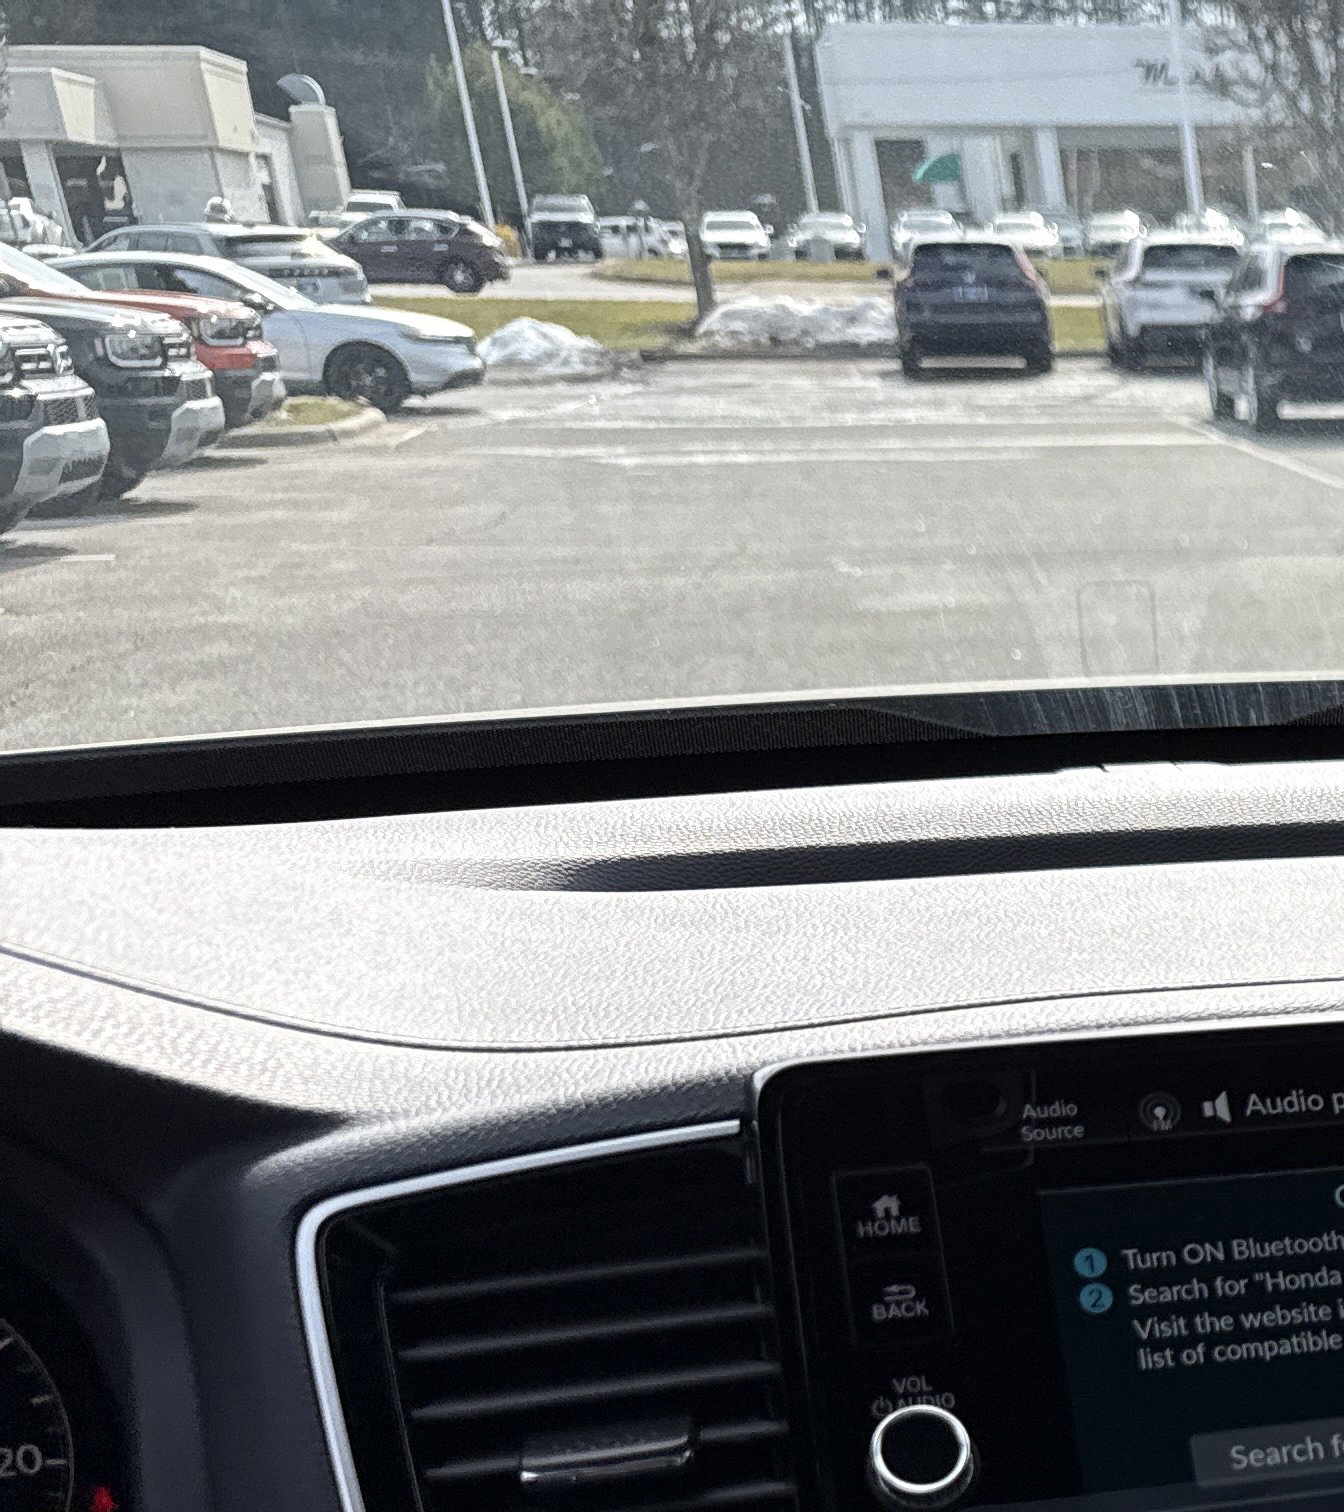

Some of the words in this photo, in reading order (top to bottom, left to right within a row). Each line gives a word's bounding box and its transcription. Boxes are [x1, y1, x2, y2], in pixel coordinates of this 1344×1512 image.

[1022, 1099, 1079, 1120] Audio
[1244, 1087, 1326, 1118] Audio
[1020, 1124, 1086, 1143] Source
[856, 1216, 922, 1238] HOME
[1122, 1246, 1176, 1272] Turn
[1183, 1240, 1226, 1266] ON
[1128, 1281, 1210, 1307] Search
[1213, 1273, 1249, 1299] for
[1253, 1263, 1343, 1296] "Honda
[871, 1299, 930, 1323] BACK
[1132, 1314, 1189, 1341] Visit
[1194, 1307, 1235, 1334] the
[1239, 1298, 1334, 1330] website
[1136, 1346, 1177, 1371] list
[1181, 1342, 1208, 1367] of
[1212, 1328, 1344, 1364] compatible
[892, 1373, 934, 1396] VOL
[1230, 1438, 1325, 1470] Search
